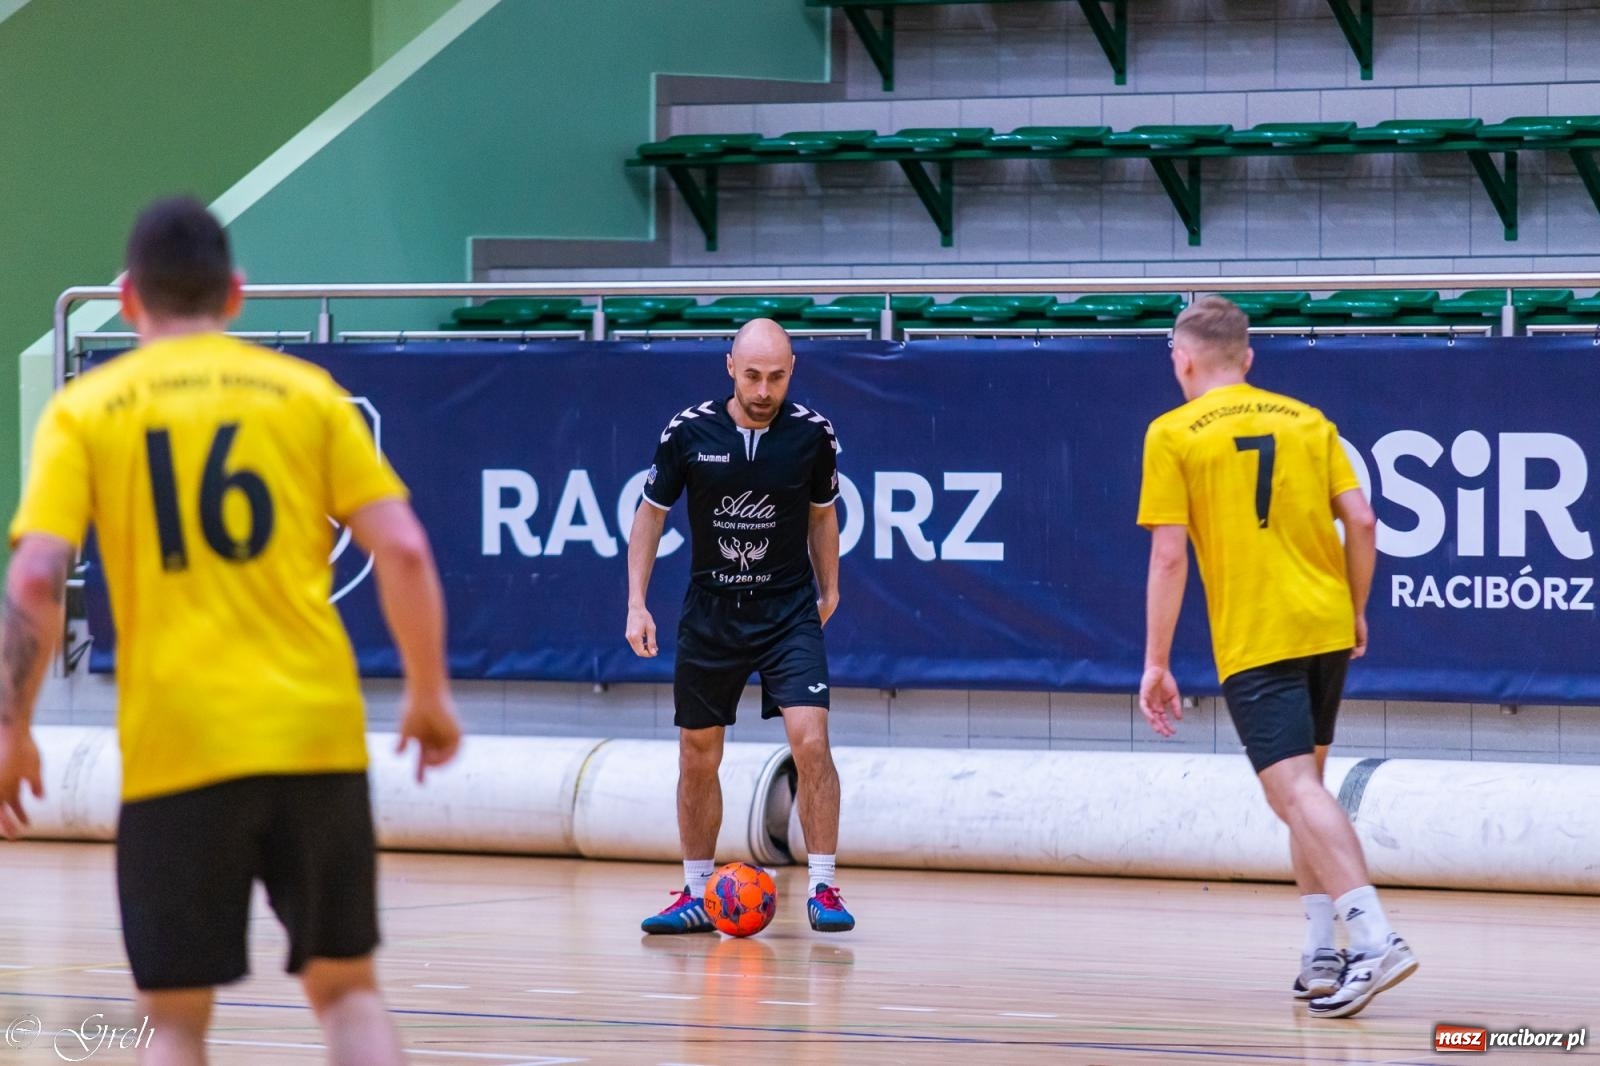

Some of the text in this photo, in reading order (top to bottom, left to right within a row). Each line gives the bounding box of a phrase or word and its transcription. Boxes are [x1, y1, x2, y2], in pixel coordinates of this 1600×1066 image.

[697, 452, 731, 463] hummel
[145, 421, 275, 572] 16
[1233, 432, 1275, 528] 7
[481, 437, 1005, 562] RACRZ
[714, 490, 776, 519] Ada
[712, 520, 777, 531] SALON FRYZJERSKI
[735, 574, 753, 583] 260
[1391, 564, 1594, 610] RACIBÓRZ
